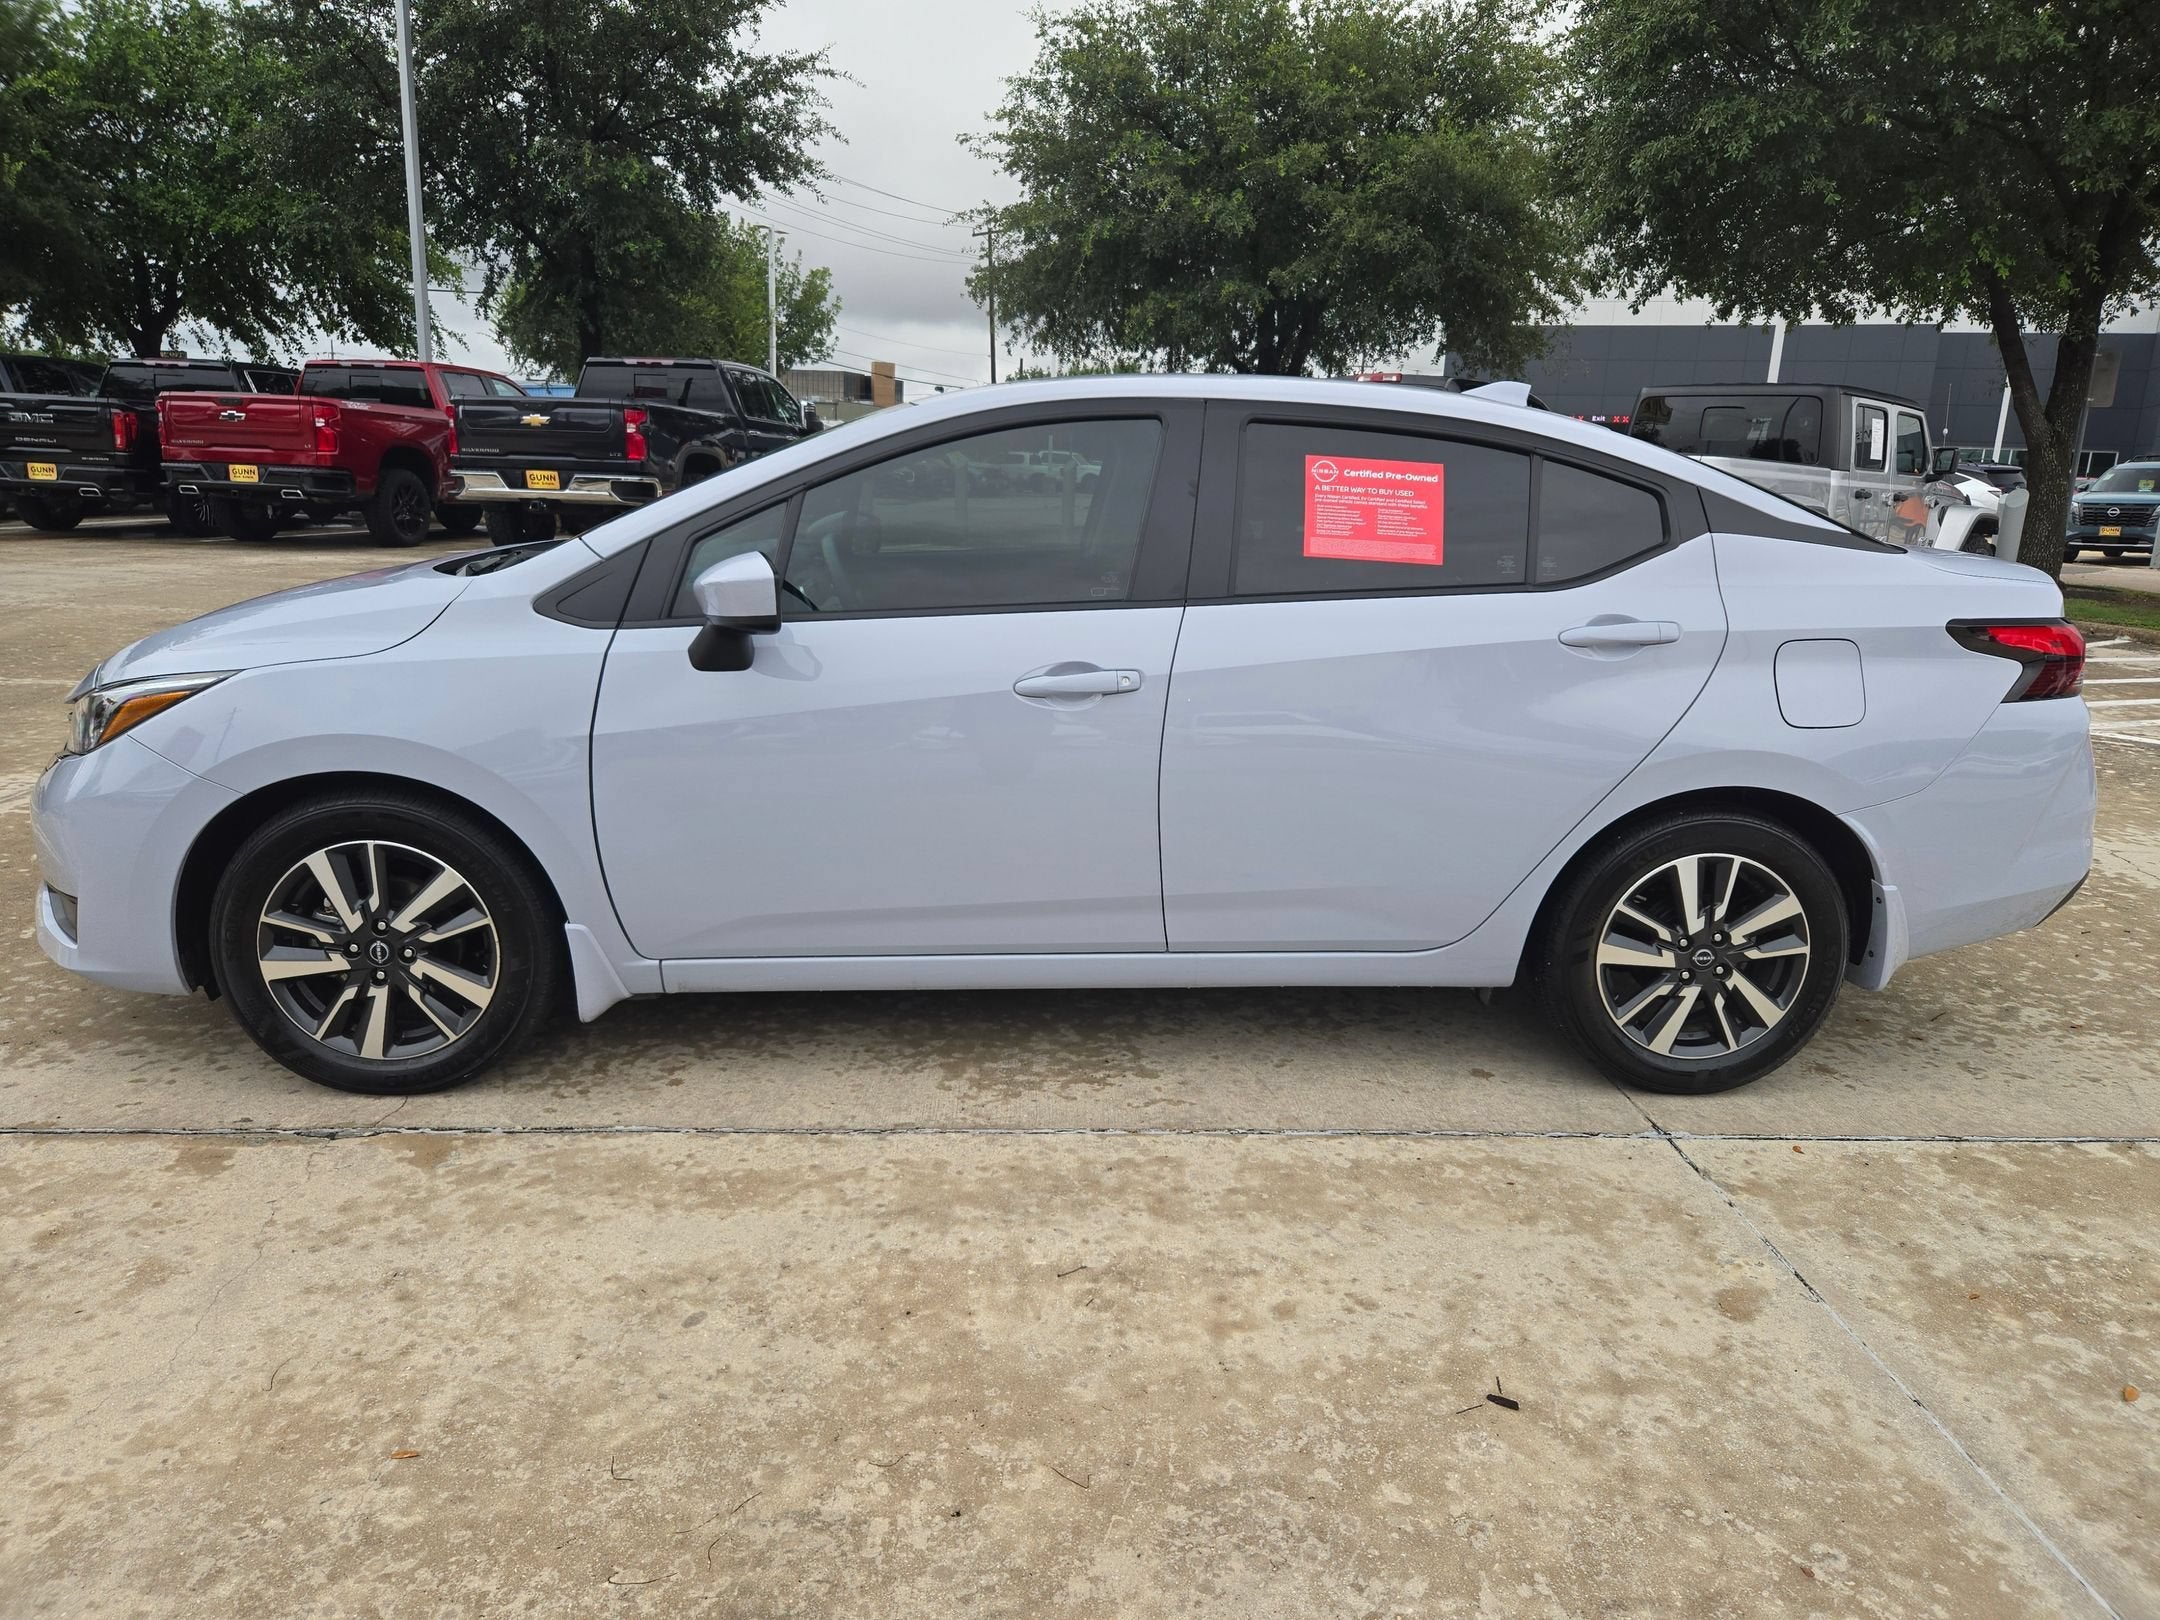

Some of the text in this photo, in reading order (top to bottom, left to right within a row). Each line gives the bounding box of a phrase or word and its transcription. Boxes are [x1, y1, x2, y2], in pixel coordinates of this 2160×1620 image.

[8, 412, 54, 423] GMC
[1591, 414, 1606, 422] Exit
[30, 465, 55, 473] GUNN
[231, 467, 256, 476] GUNN
[529, 473, 557, 482] GUNN
[1343, 469, 1439, 483] Certified Pre-Owned
[1321, 485, 1350, 493] BETTER
